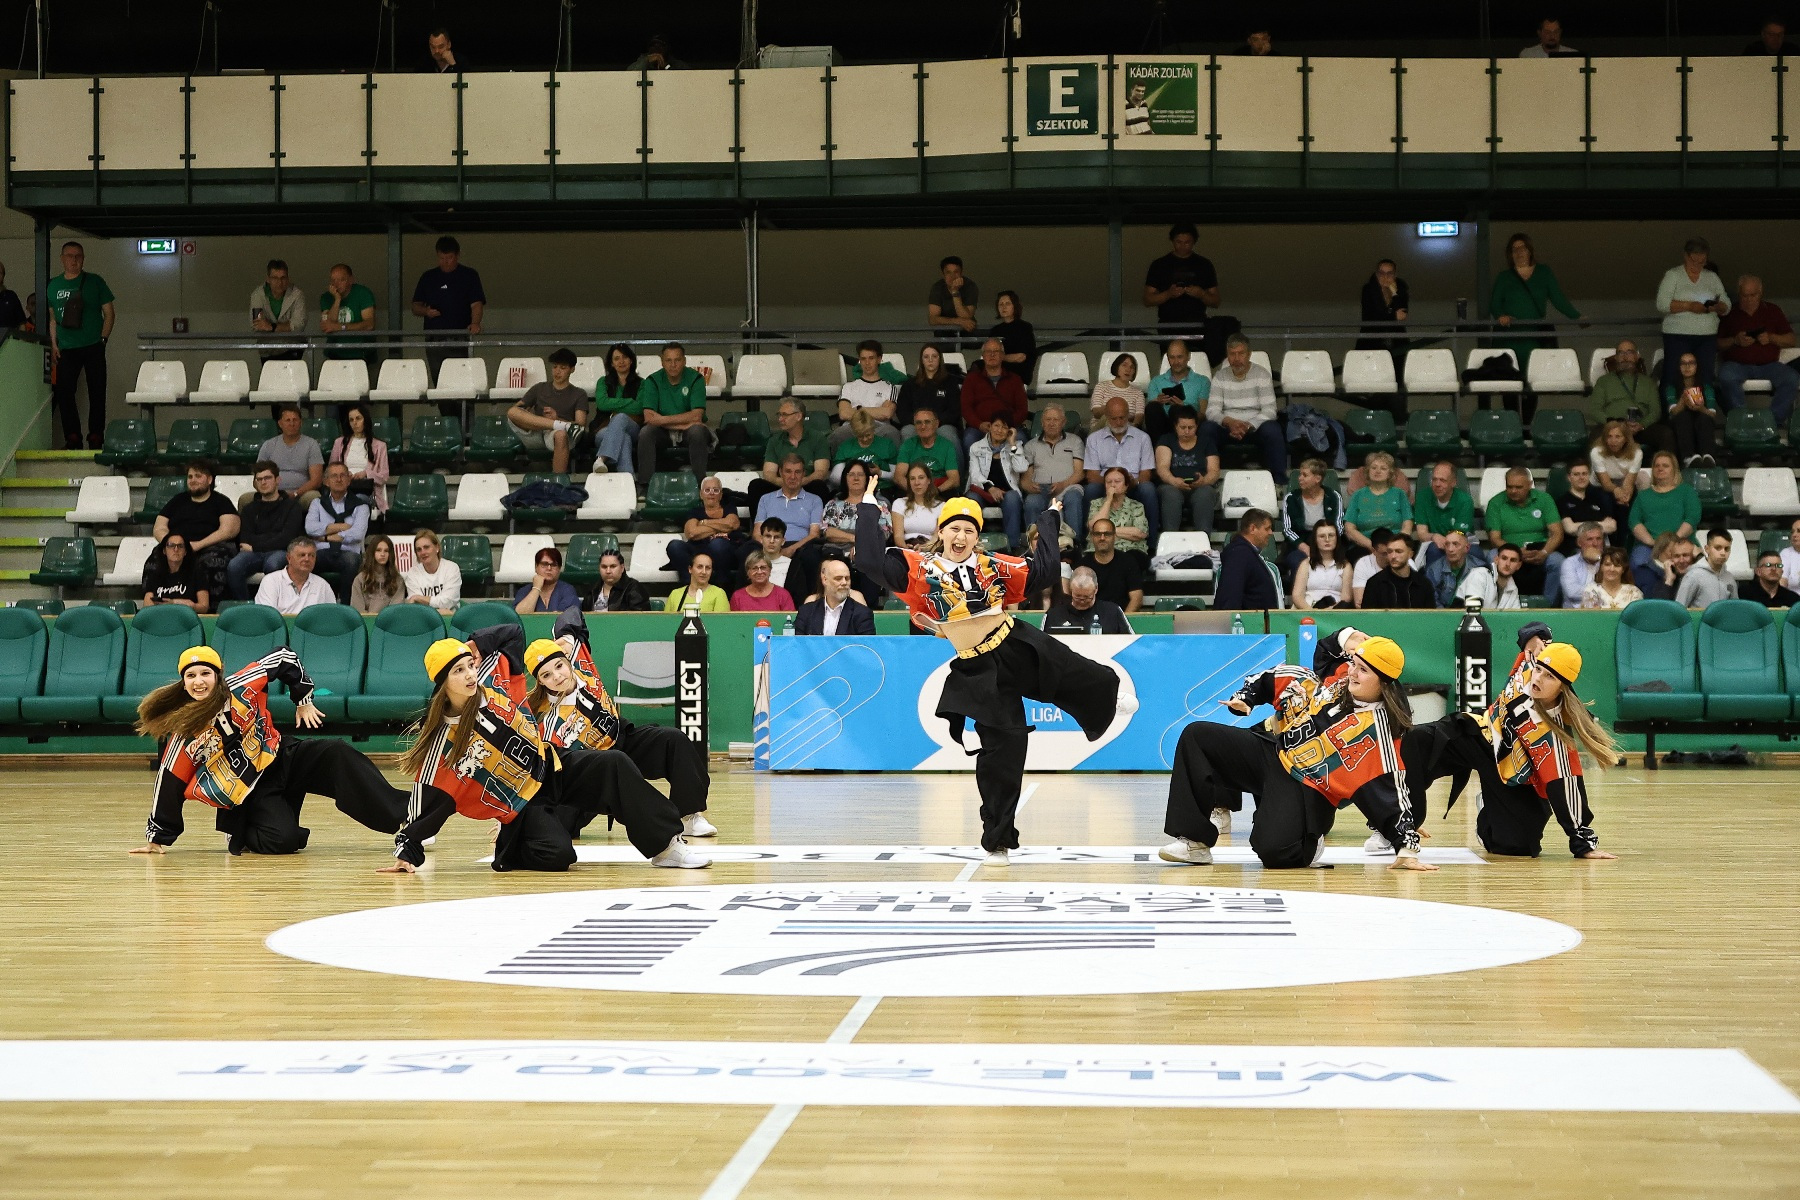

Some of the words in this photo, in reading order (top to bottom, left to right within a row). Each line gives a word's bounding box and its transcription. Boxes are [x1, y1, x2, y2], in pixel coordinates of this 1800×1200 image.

[1130, 65, 1160, 79] KÁDÁR
[1160, 65, 1193, 79] ZOLTÁN
[1049, 69, 1080, 114] E
[1036, 119, 1089, 131] SZEKTOR
[1466, 656, 1487, 713] LECT
[680, 661, 702, 742] SELECT
[1032, 707, 1064, 722] LIGA
[1325, 713, 1377, 772] LA
[727, 895, 1284, 905] EGYETEM
[604, 903, 1288, 915] SZÉCHENYI
[178, 1064, 473, 1076] KFT
[515, 1063, 934, 1079] 2000
[980, 1068, 1454, 1082] WILLE
